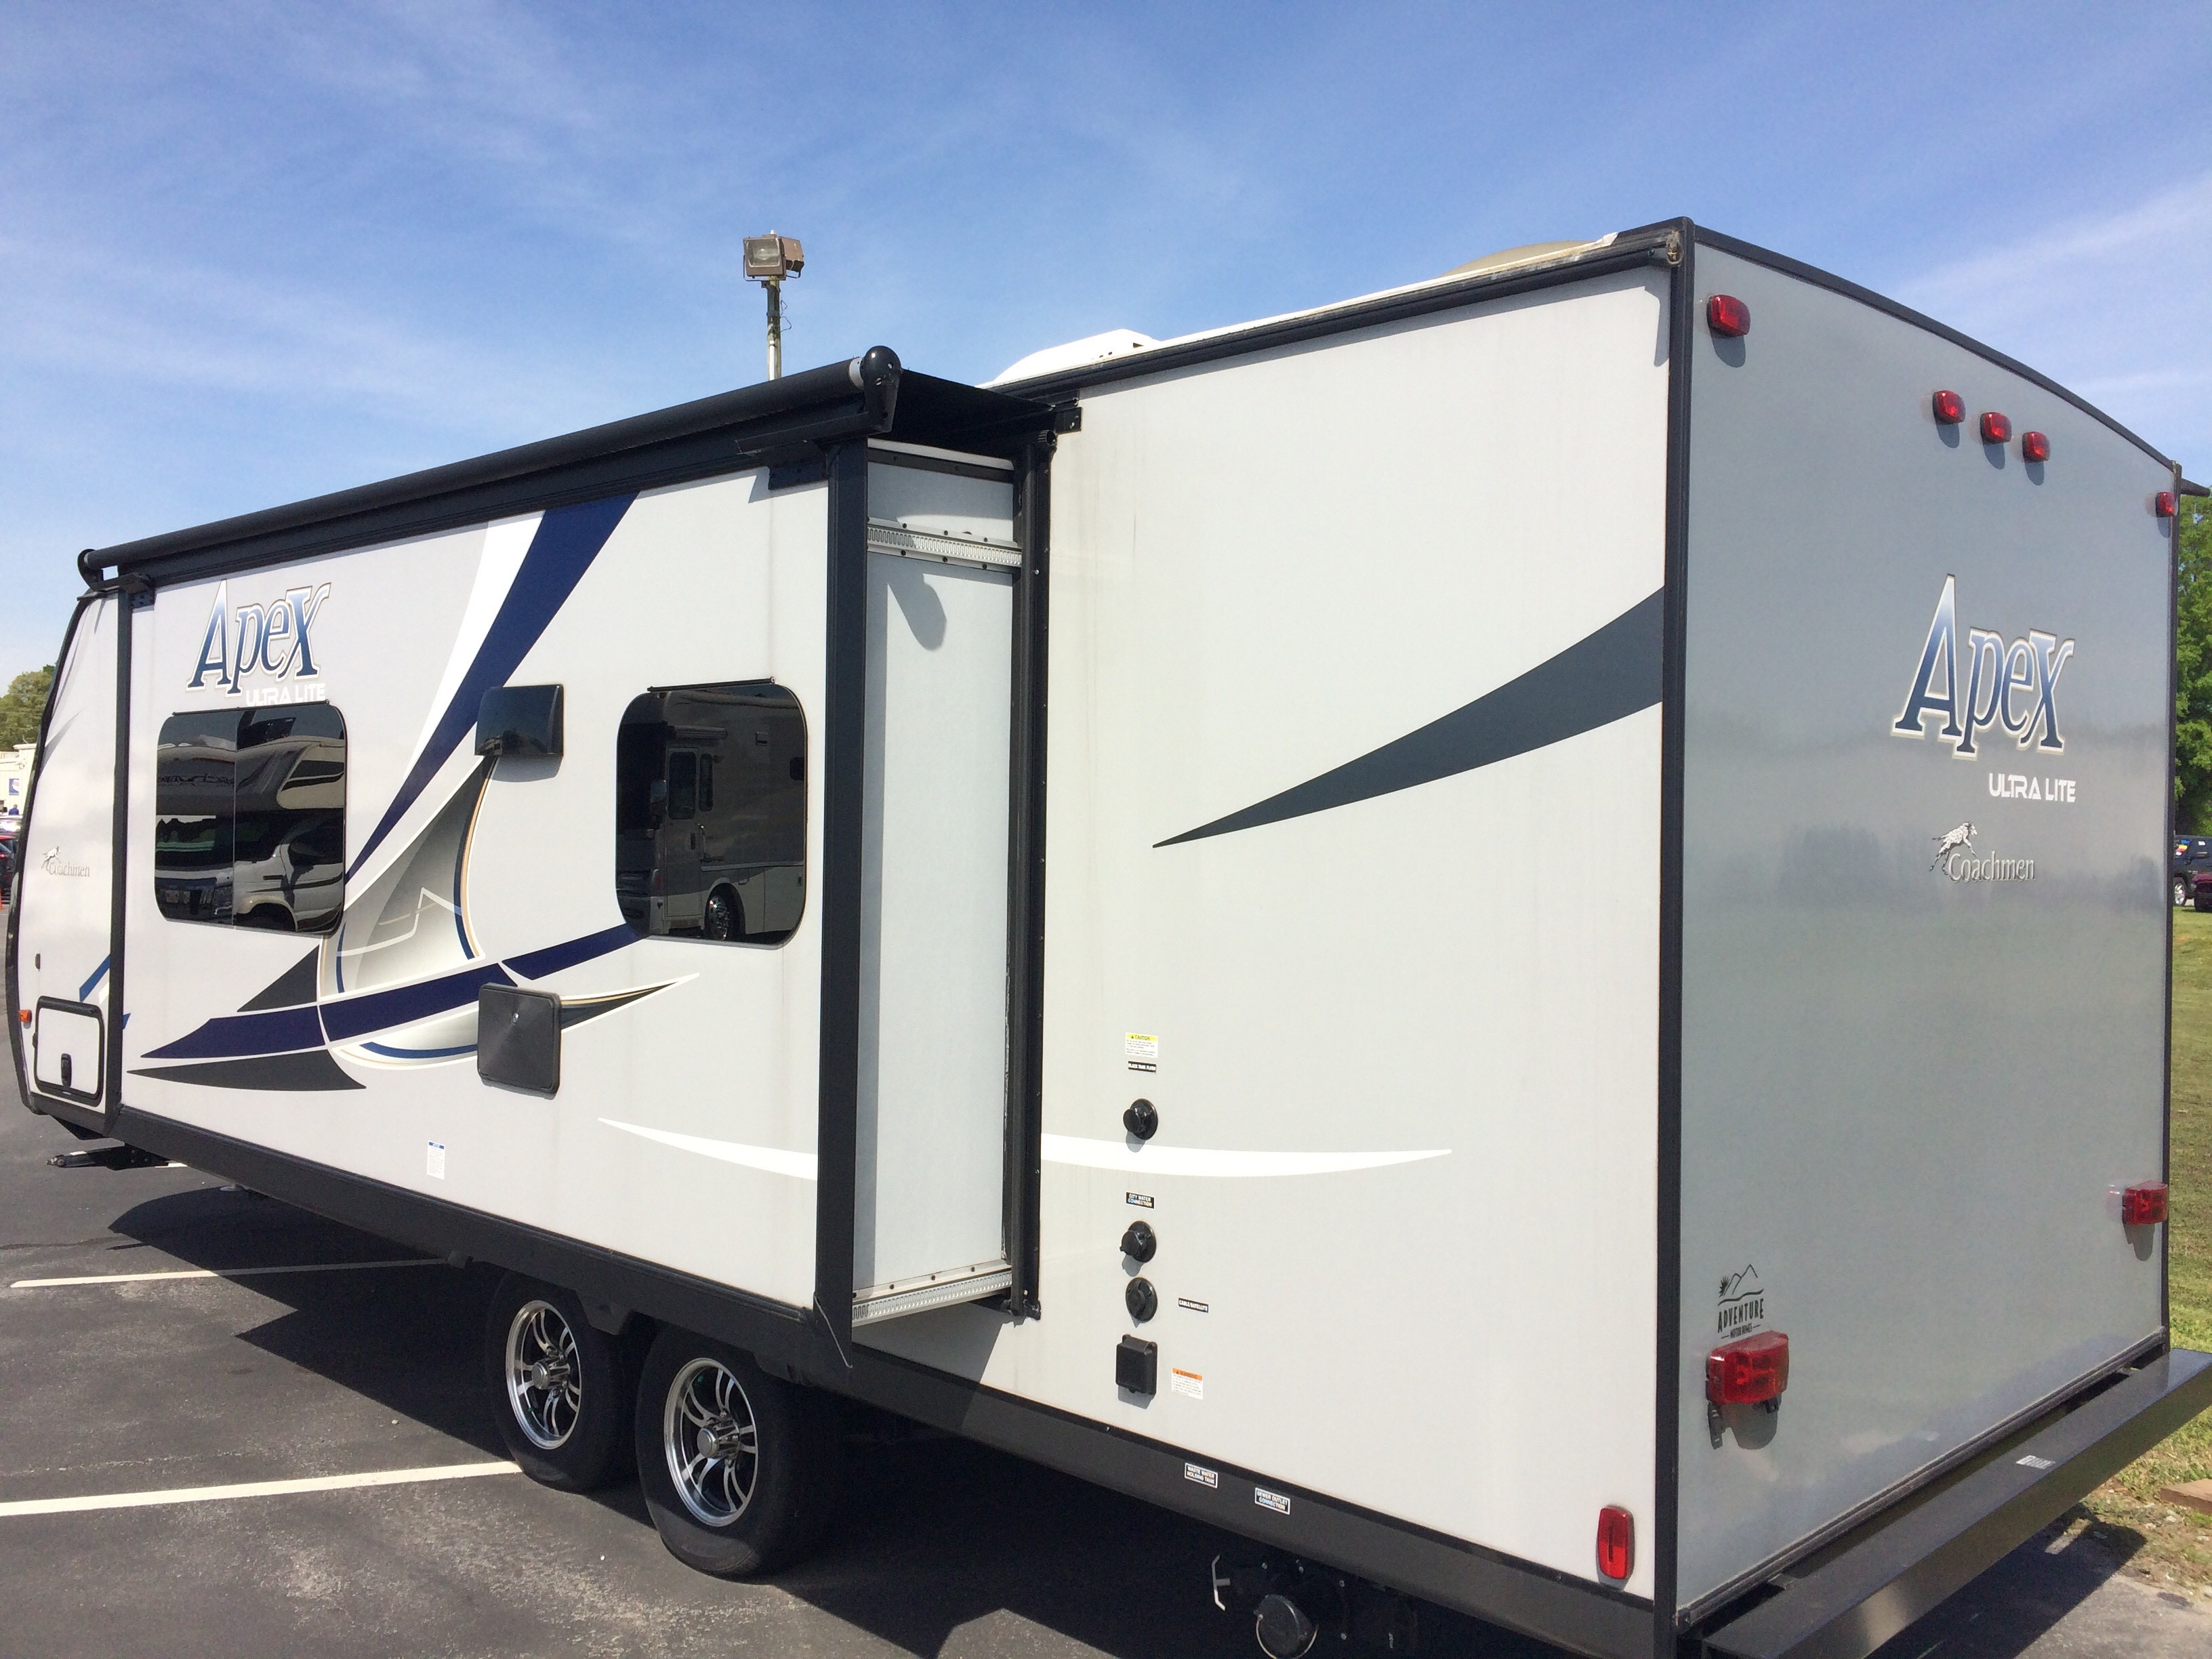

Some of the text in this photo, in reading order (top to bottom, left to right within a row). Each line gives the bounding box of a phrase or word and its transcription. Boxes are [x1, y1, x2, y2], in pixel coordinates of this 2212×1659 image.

[186, 578, 331, 697] Apex
[1891, 574, 2075, 760] Apex
[246, 683, 326, 706] ULTRA LITE
[1989, 773, 2076, 802] ULTRA LITE
[49, 861, 90, 877] Coachmen
[1948, 850, 2036, 884] Coachmen
[1128, 1198, 1152, 1208] CONNECTION
[1717, 1298, 1764, 1334] ADVENTURE
[1187, 1465, 1214, 1478] WASTE WATER
[1187, 1471, 1215, 1484] HOLDING TANK
[1256, 1490, 1288, 1506] SEWER OUTLET
[1258, 1496, 1286, 1511] CONNECTION
